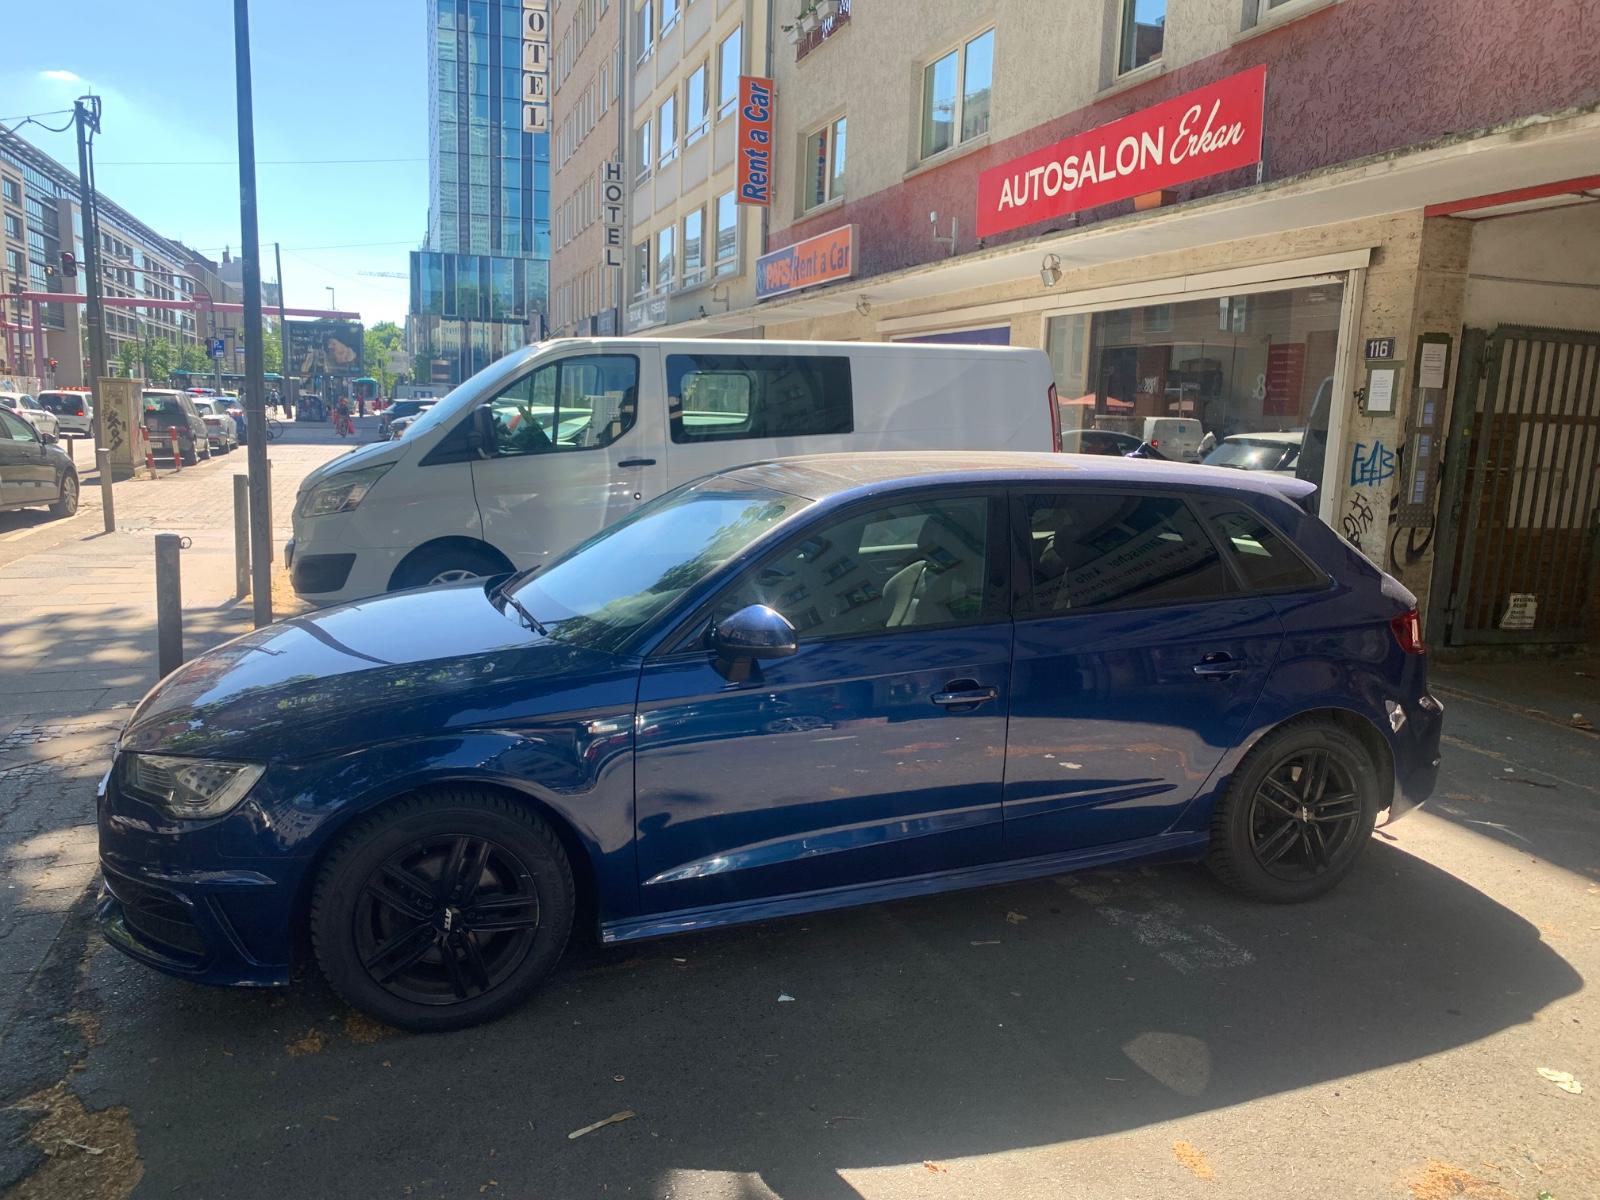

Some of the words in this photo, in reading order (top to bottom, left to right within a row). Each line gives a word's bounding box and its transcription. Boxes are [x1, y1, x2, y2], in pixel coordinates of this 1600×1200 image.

[527, 11, 545, 127] OTEL
[743, 81, 769, 122] Car
[749, 128, 769, 143] a
[998, 126, 1165, 211] AUTOSALON
[1169, 98, 1245, 165] Erkan
[742, 148, 769, 201] Rent
[606, 162, 622, 267] HOTEL
[791, 249, 818, 280] Rent
[821, 254, 826, 272] a
[830, 241, 849, 270] Car
[1369, 340, 1388, 358] 116
